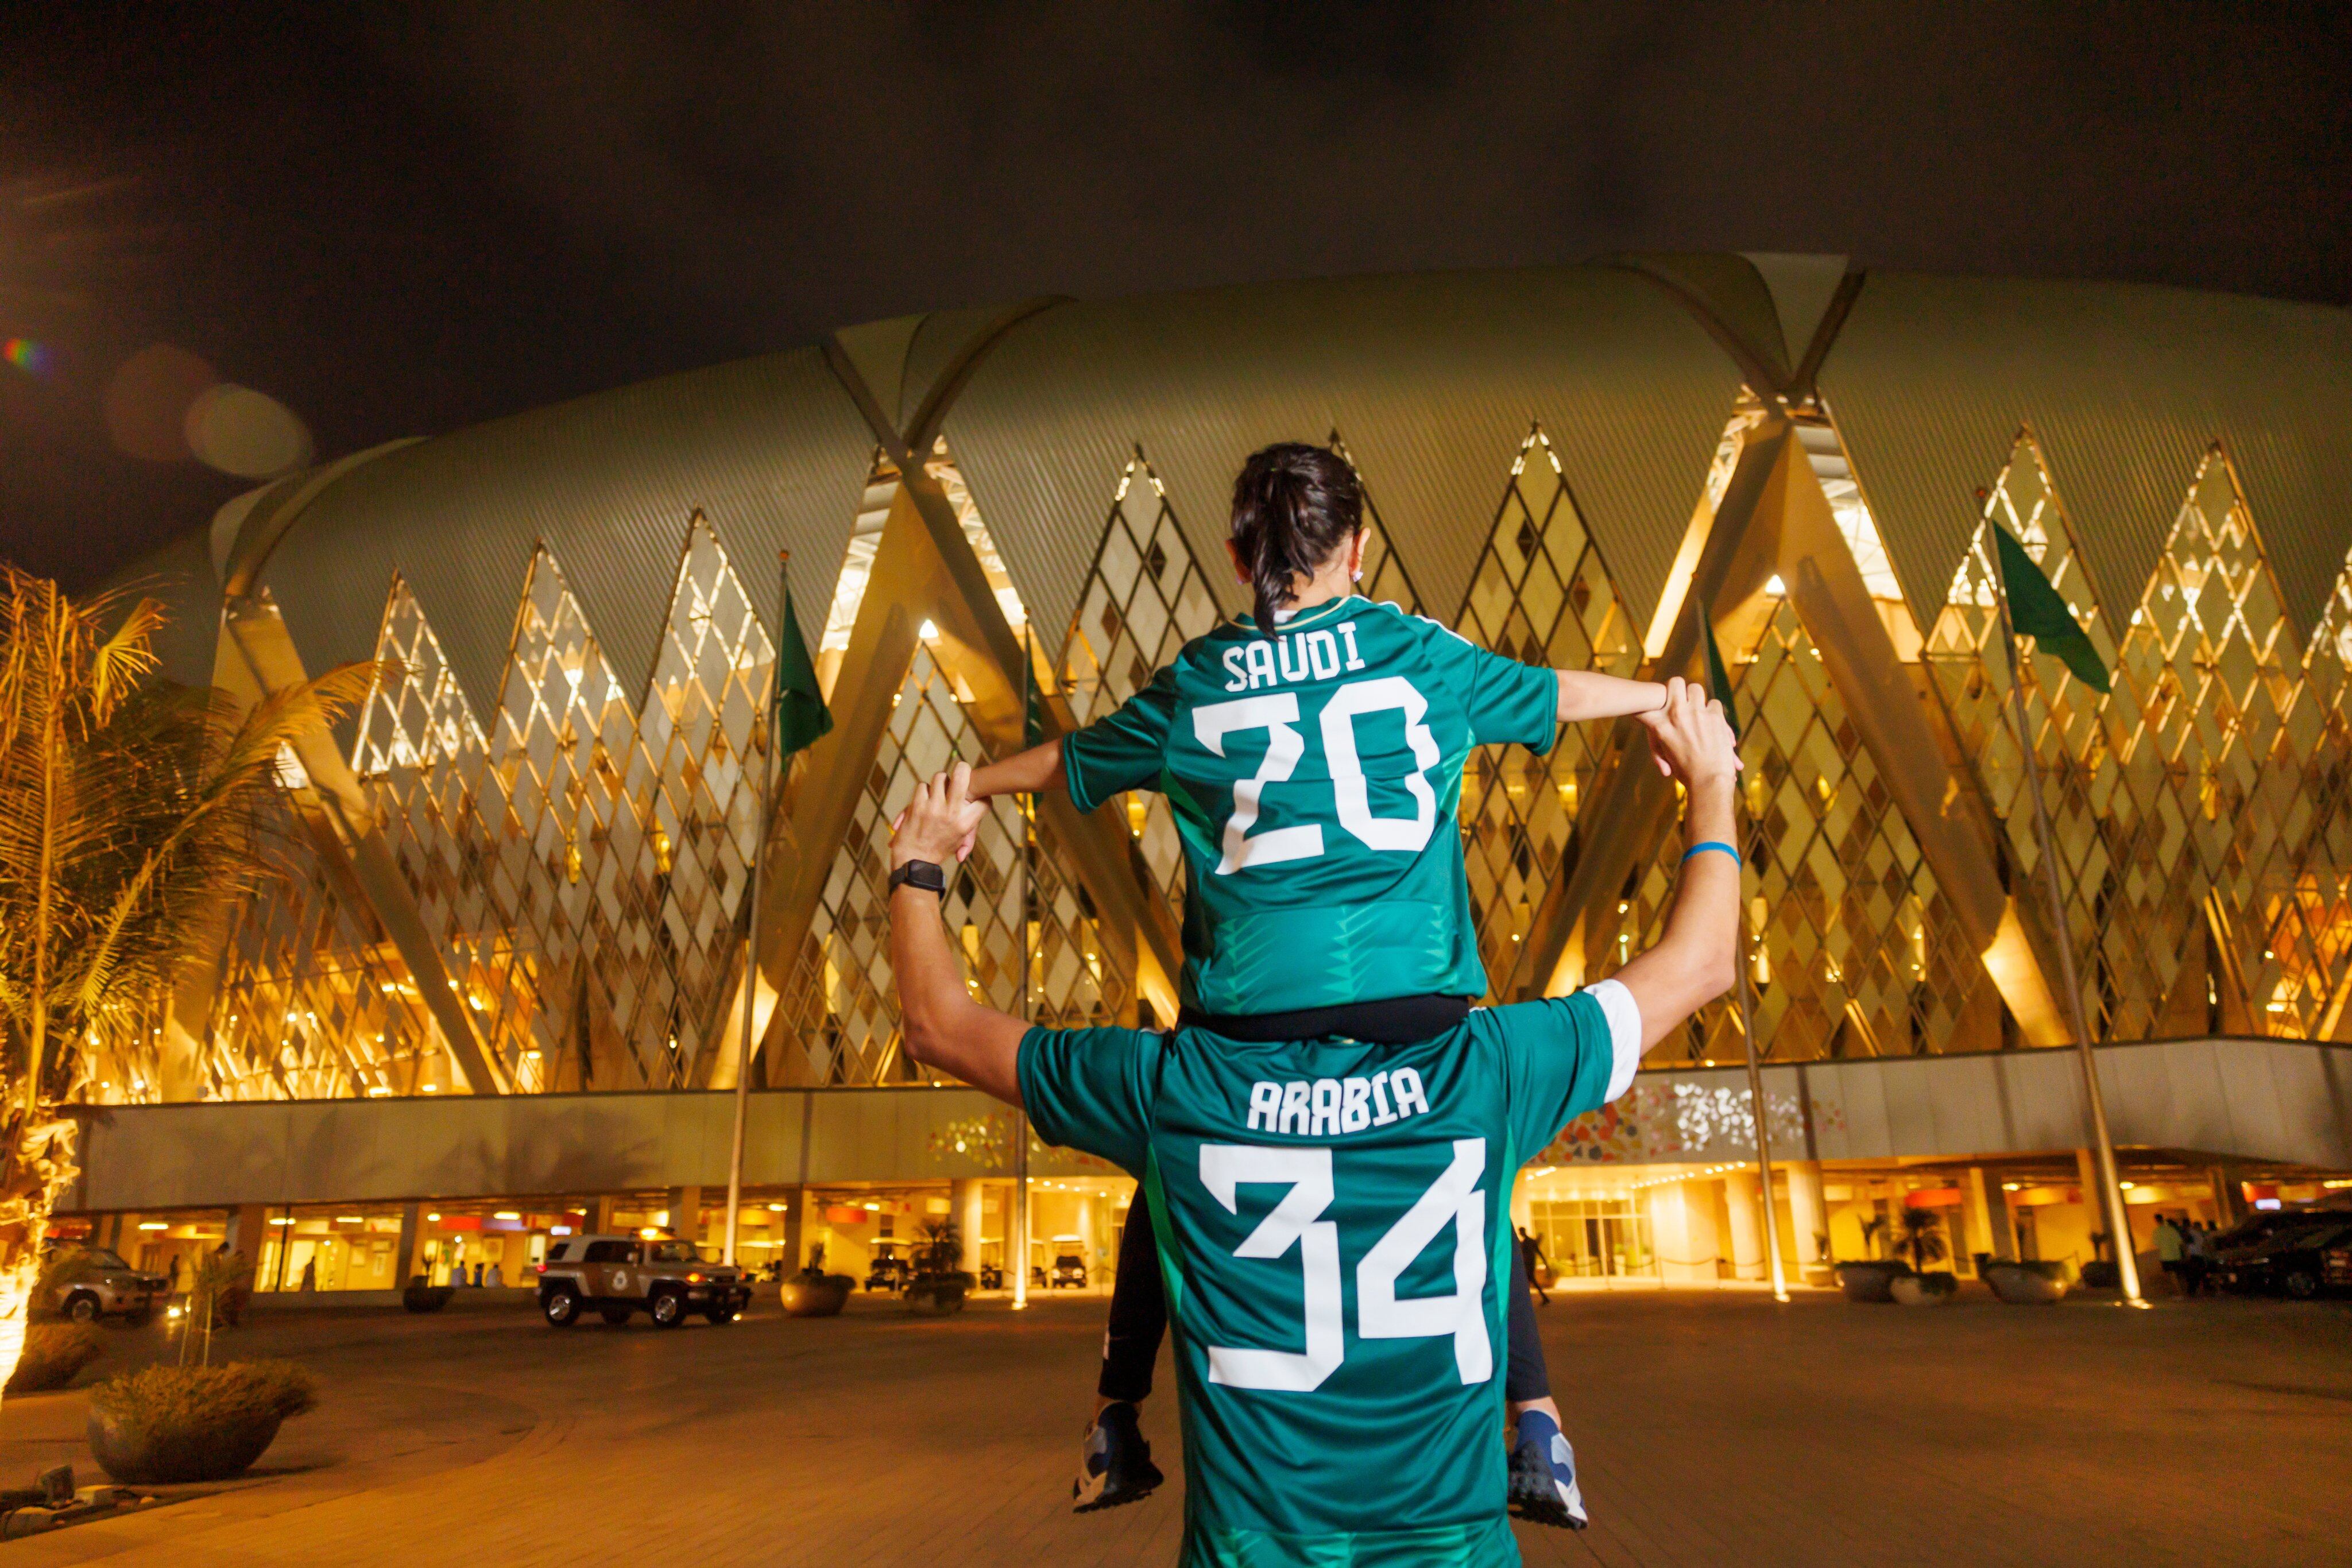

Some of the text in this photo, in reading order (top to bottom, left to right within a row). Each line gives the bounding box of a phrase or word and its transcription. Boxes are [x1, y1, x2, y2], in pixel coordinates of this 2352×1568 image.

[1223, 622, 1365, 692] SAUDI
[1192, 676, 1440, 875] 20
[1247, 1067, 1429, 1135] ARABIA
[1200, 1137, 1492, 1392] 34
